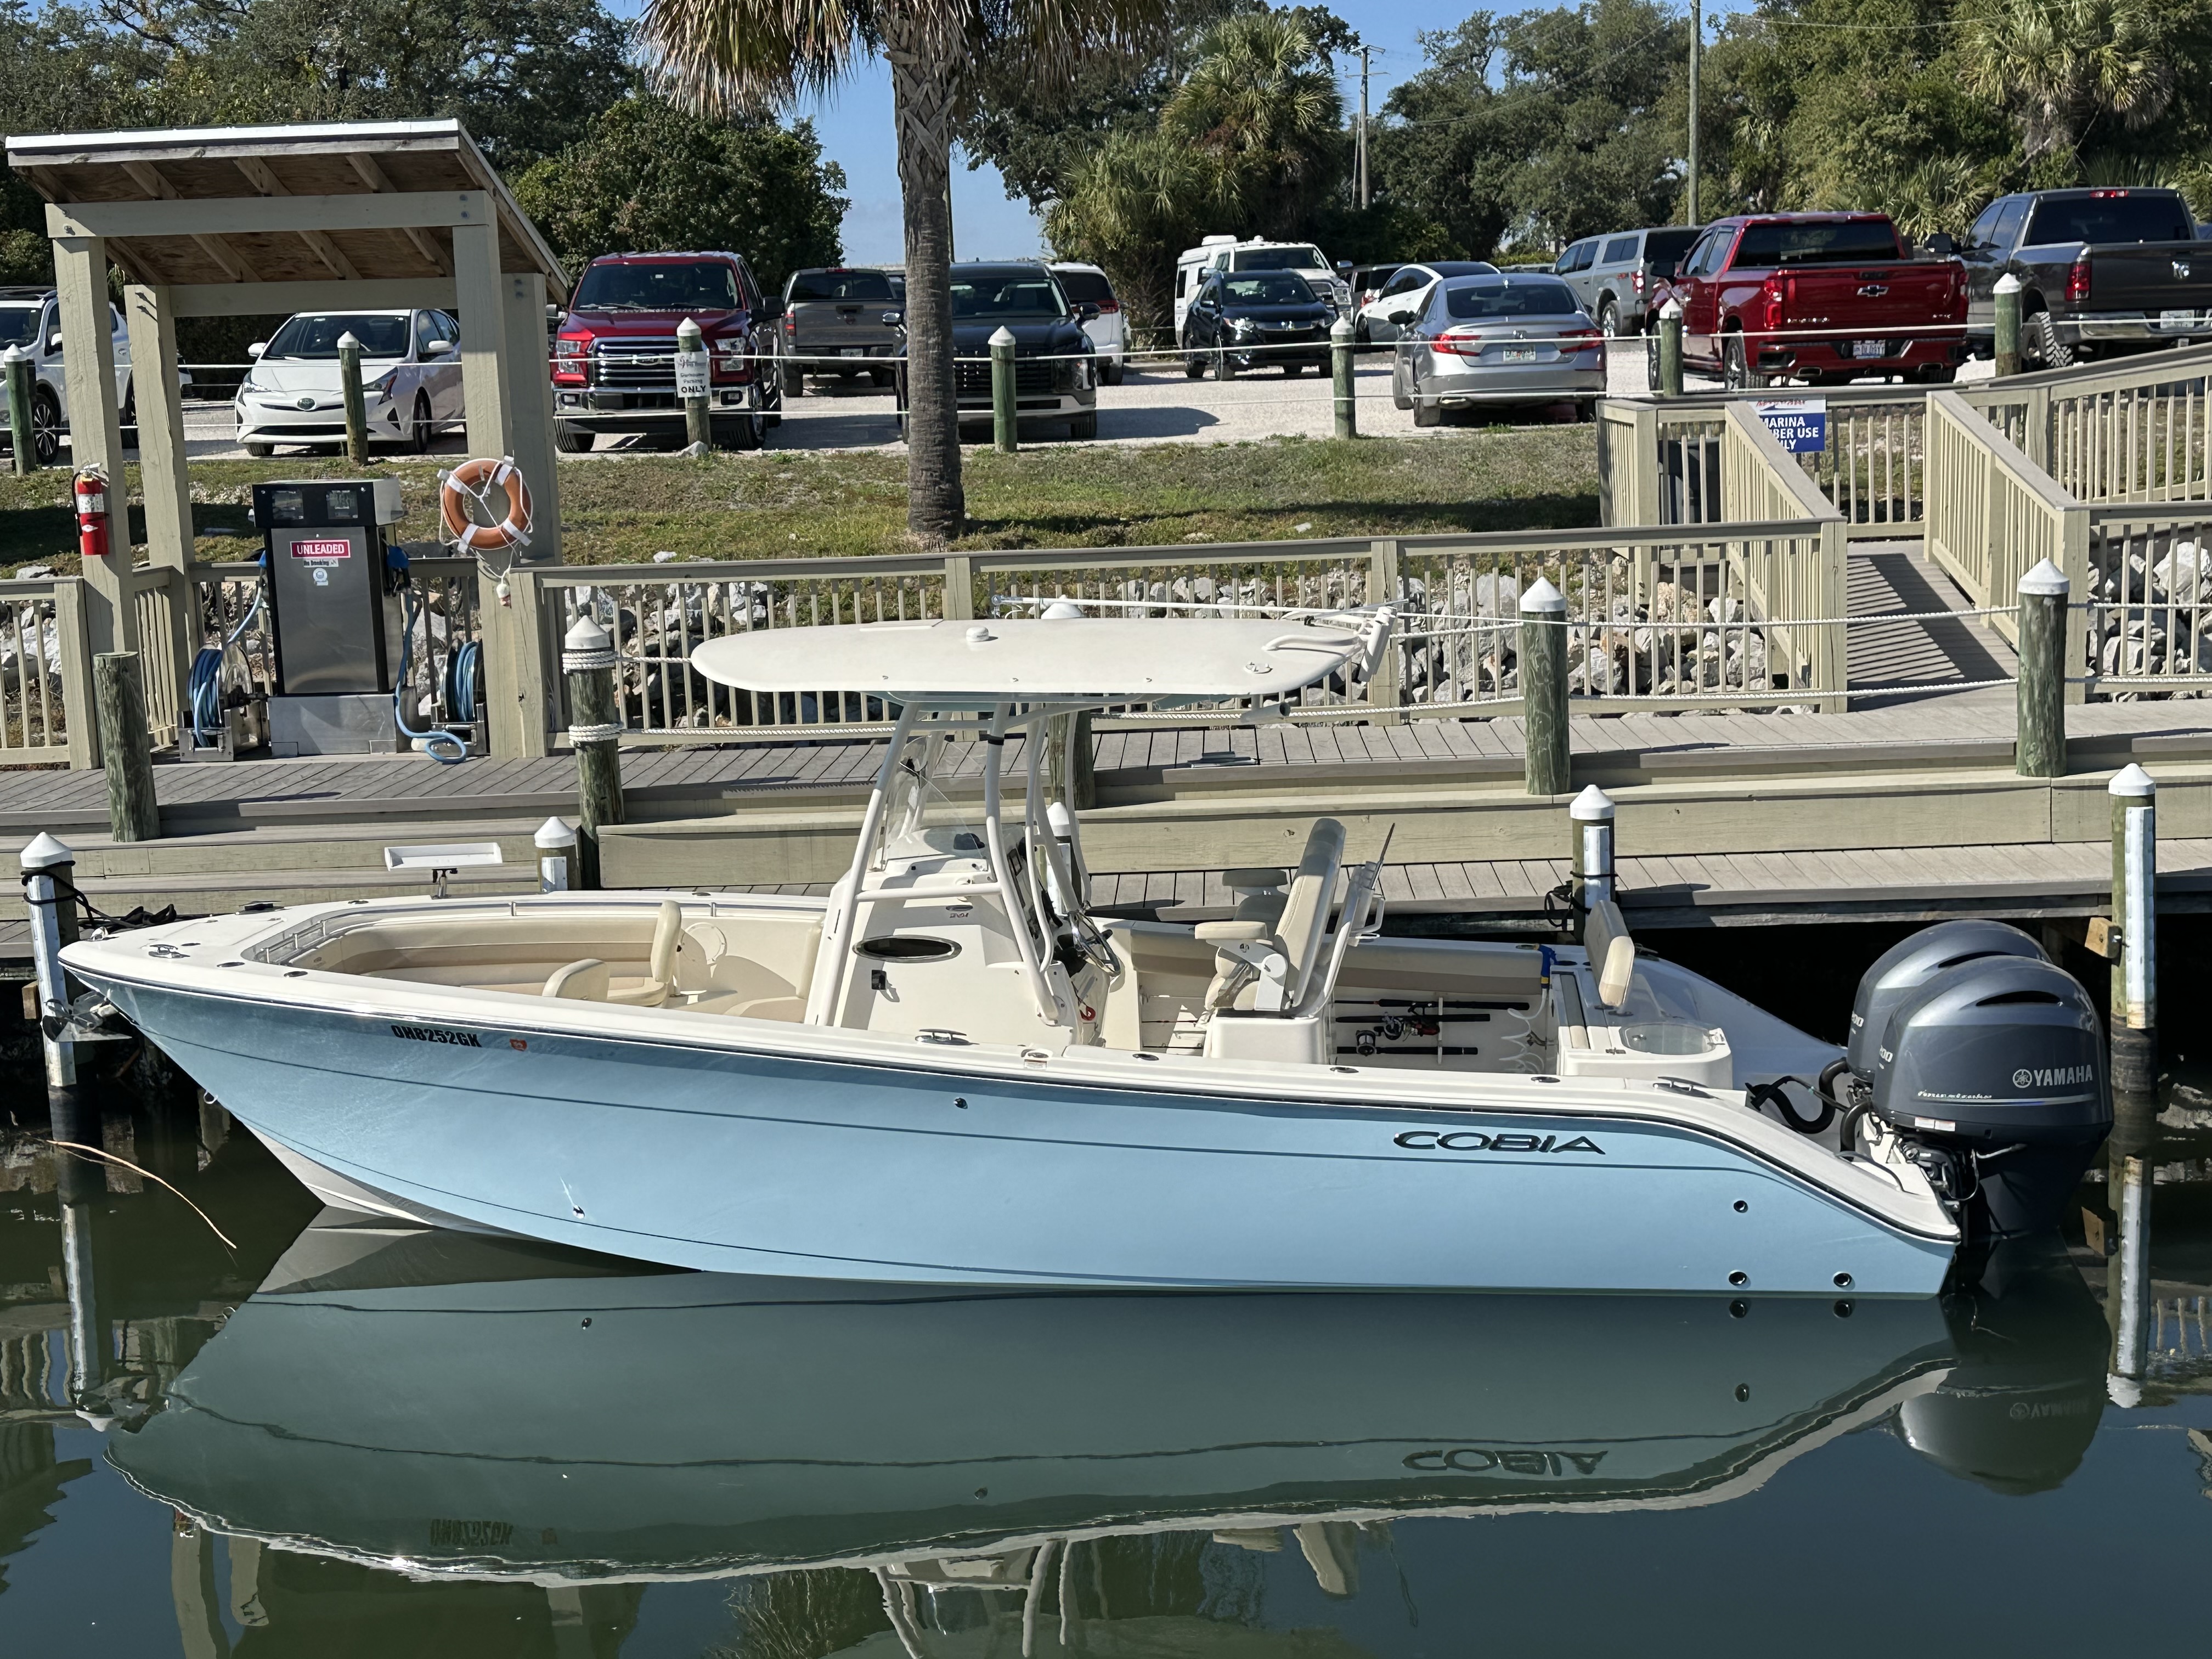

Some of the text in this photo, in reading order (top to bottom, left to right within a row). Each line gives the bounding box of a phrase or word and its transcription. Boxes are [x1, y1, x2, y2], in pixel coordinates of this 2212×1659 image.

[681, 385, 706, 393] ONLY
[1771, 427, 1819, 439] BER USE
[297, 544, 345, 555] UNLEADED
[391, 1024, 482, 1048] OH8252GK
[2034, 1064, 2093, 1087] YAMAHA
[1393, 1131, 1606, 1155] COBIA
